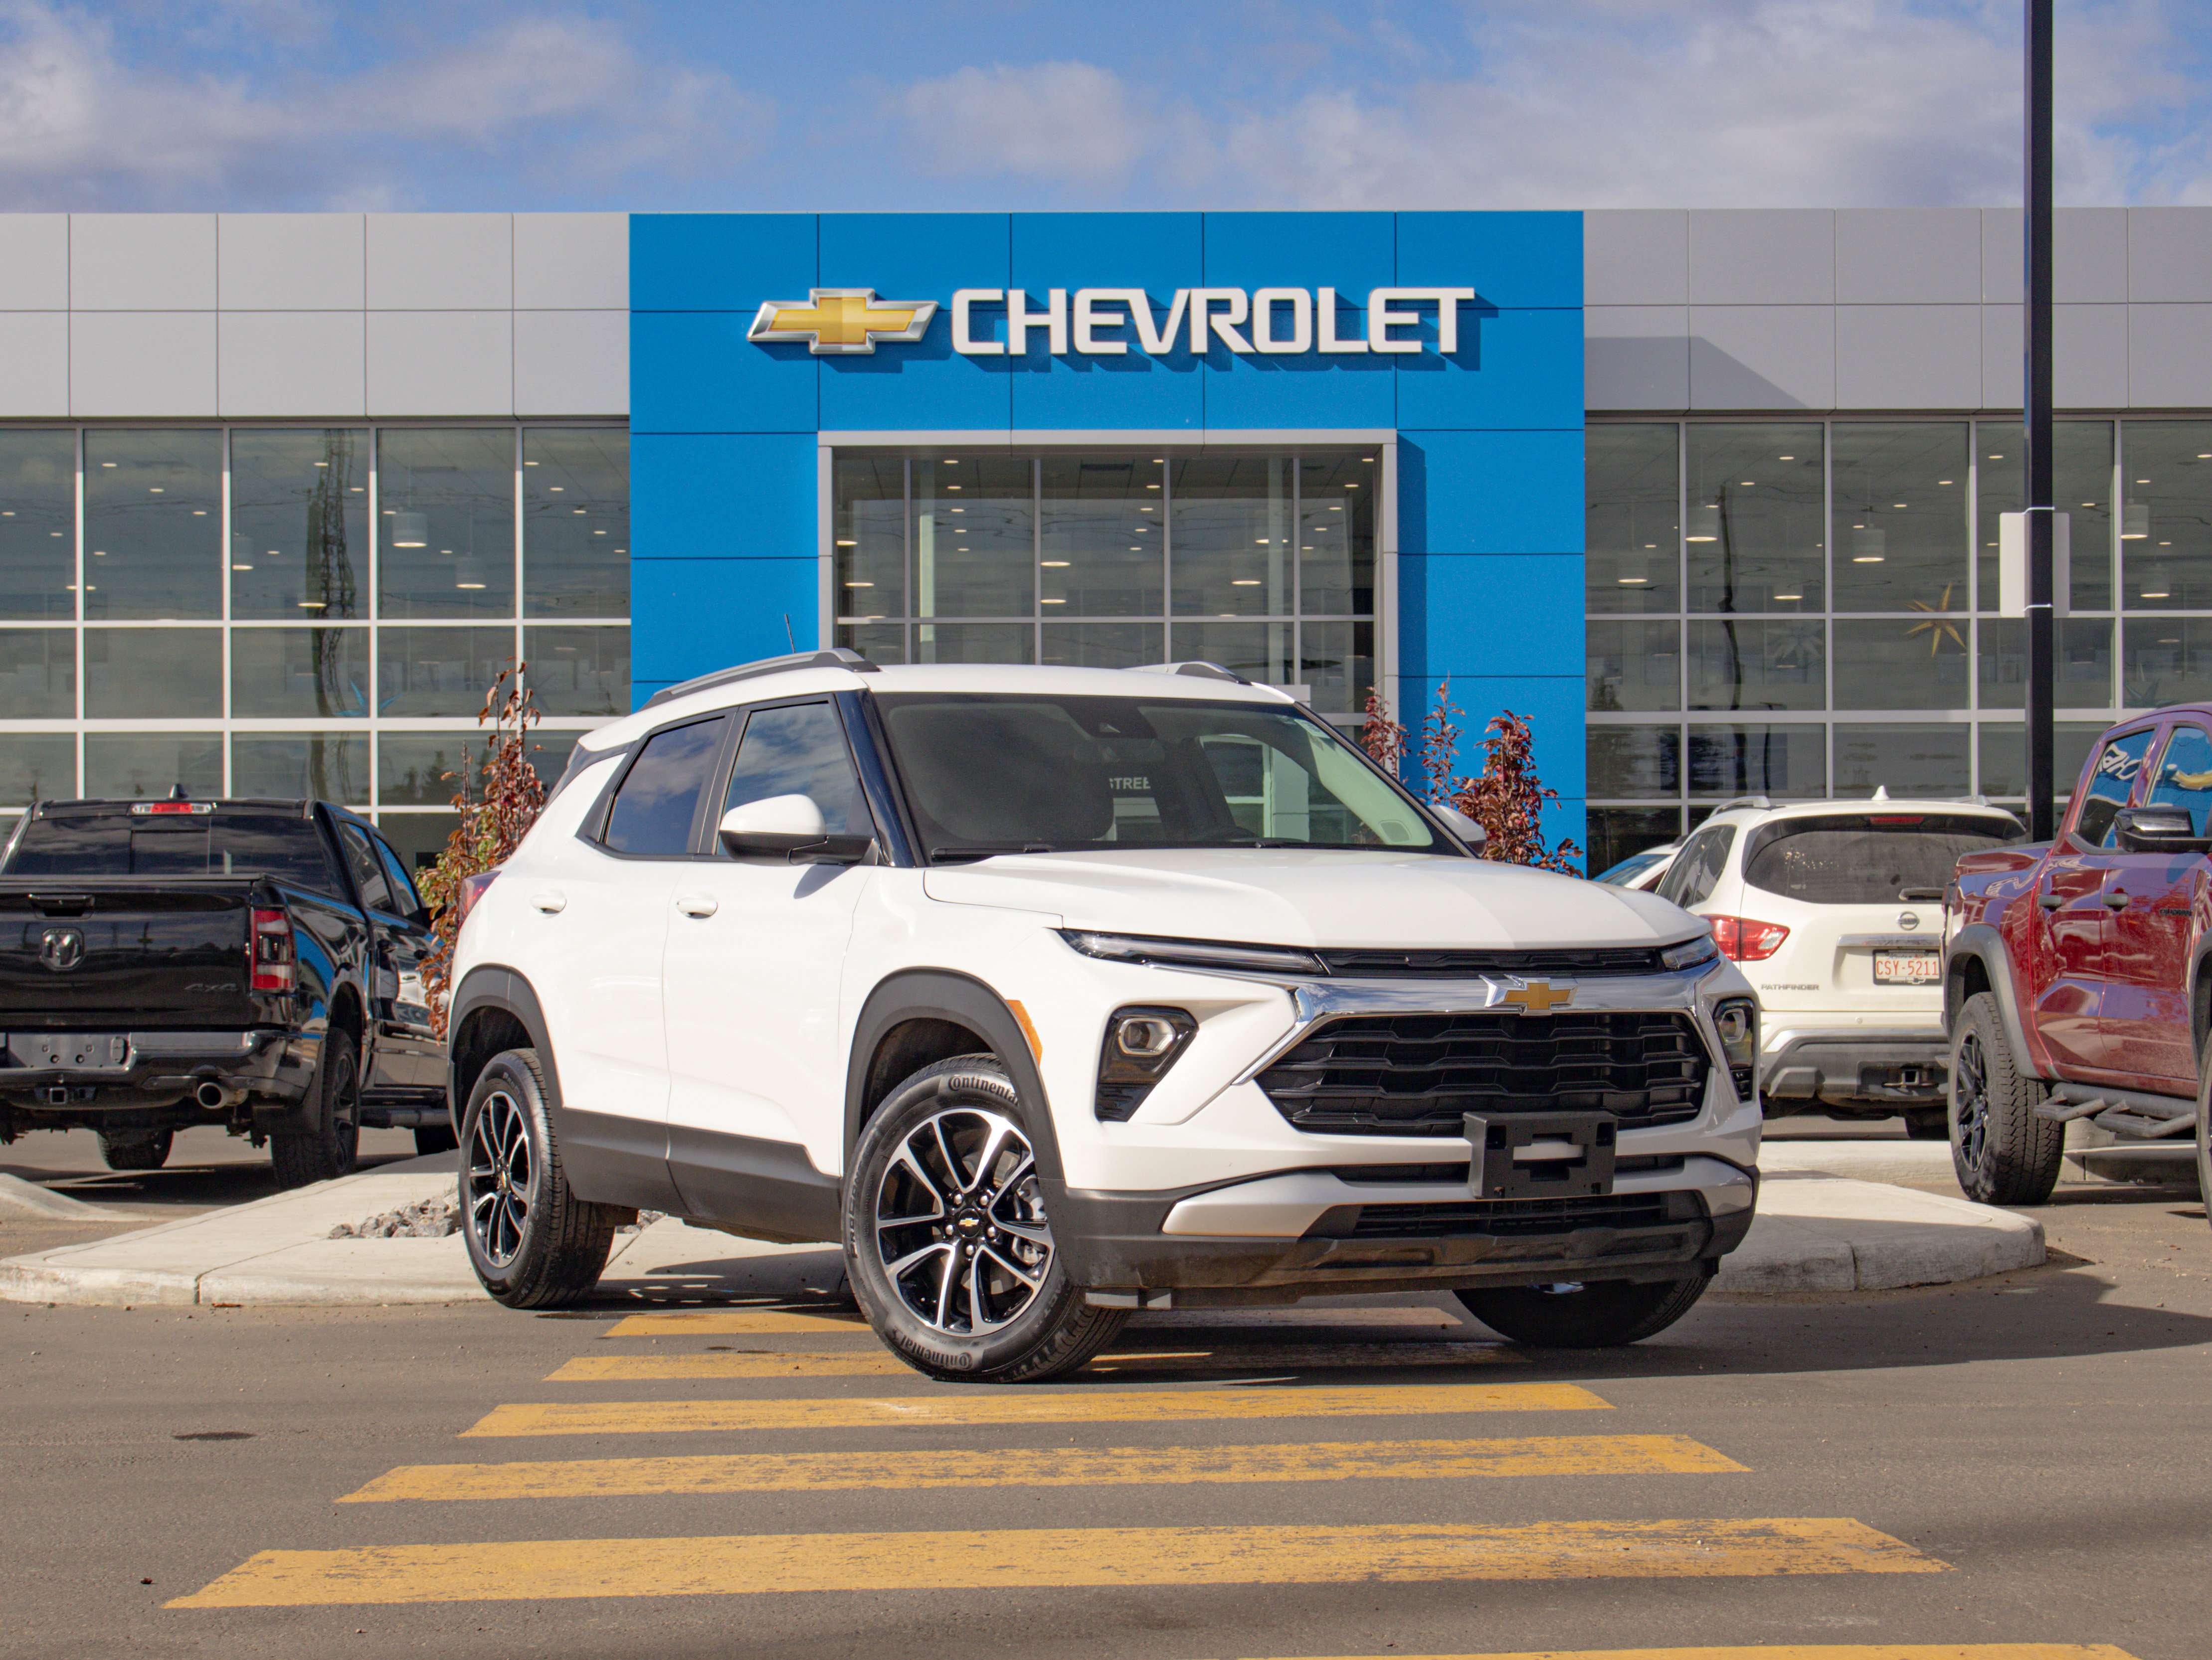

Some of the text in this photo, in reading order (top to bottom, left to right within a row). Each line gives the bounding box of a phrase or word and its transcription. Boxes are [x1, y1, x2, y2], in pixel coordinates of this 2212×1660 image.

[952, 288, 1475, 354] CHEVROLET
[1876, 961, 1938, 975] CSY-5211
[901, 1334, 973, 1369] Continental
